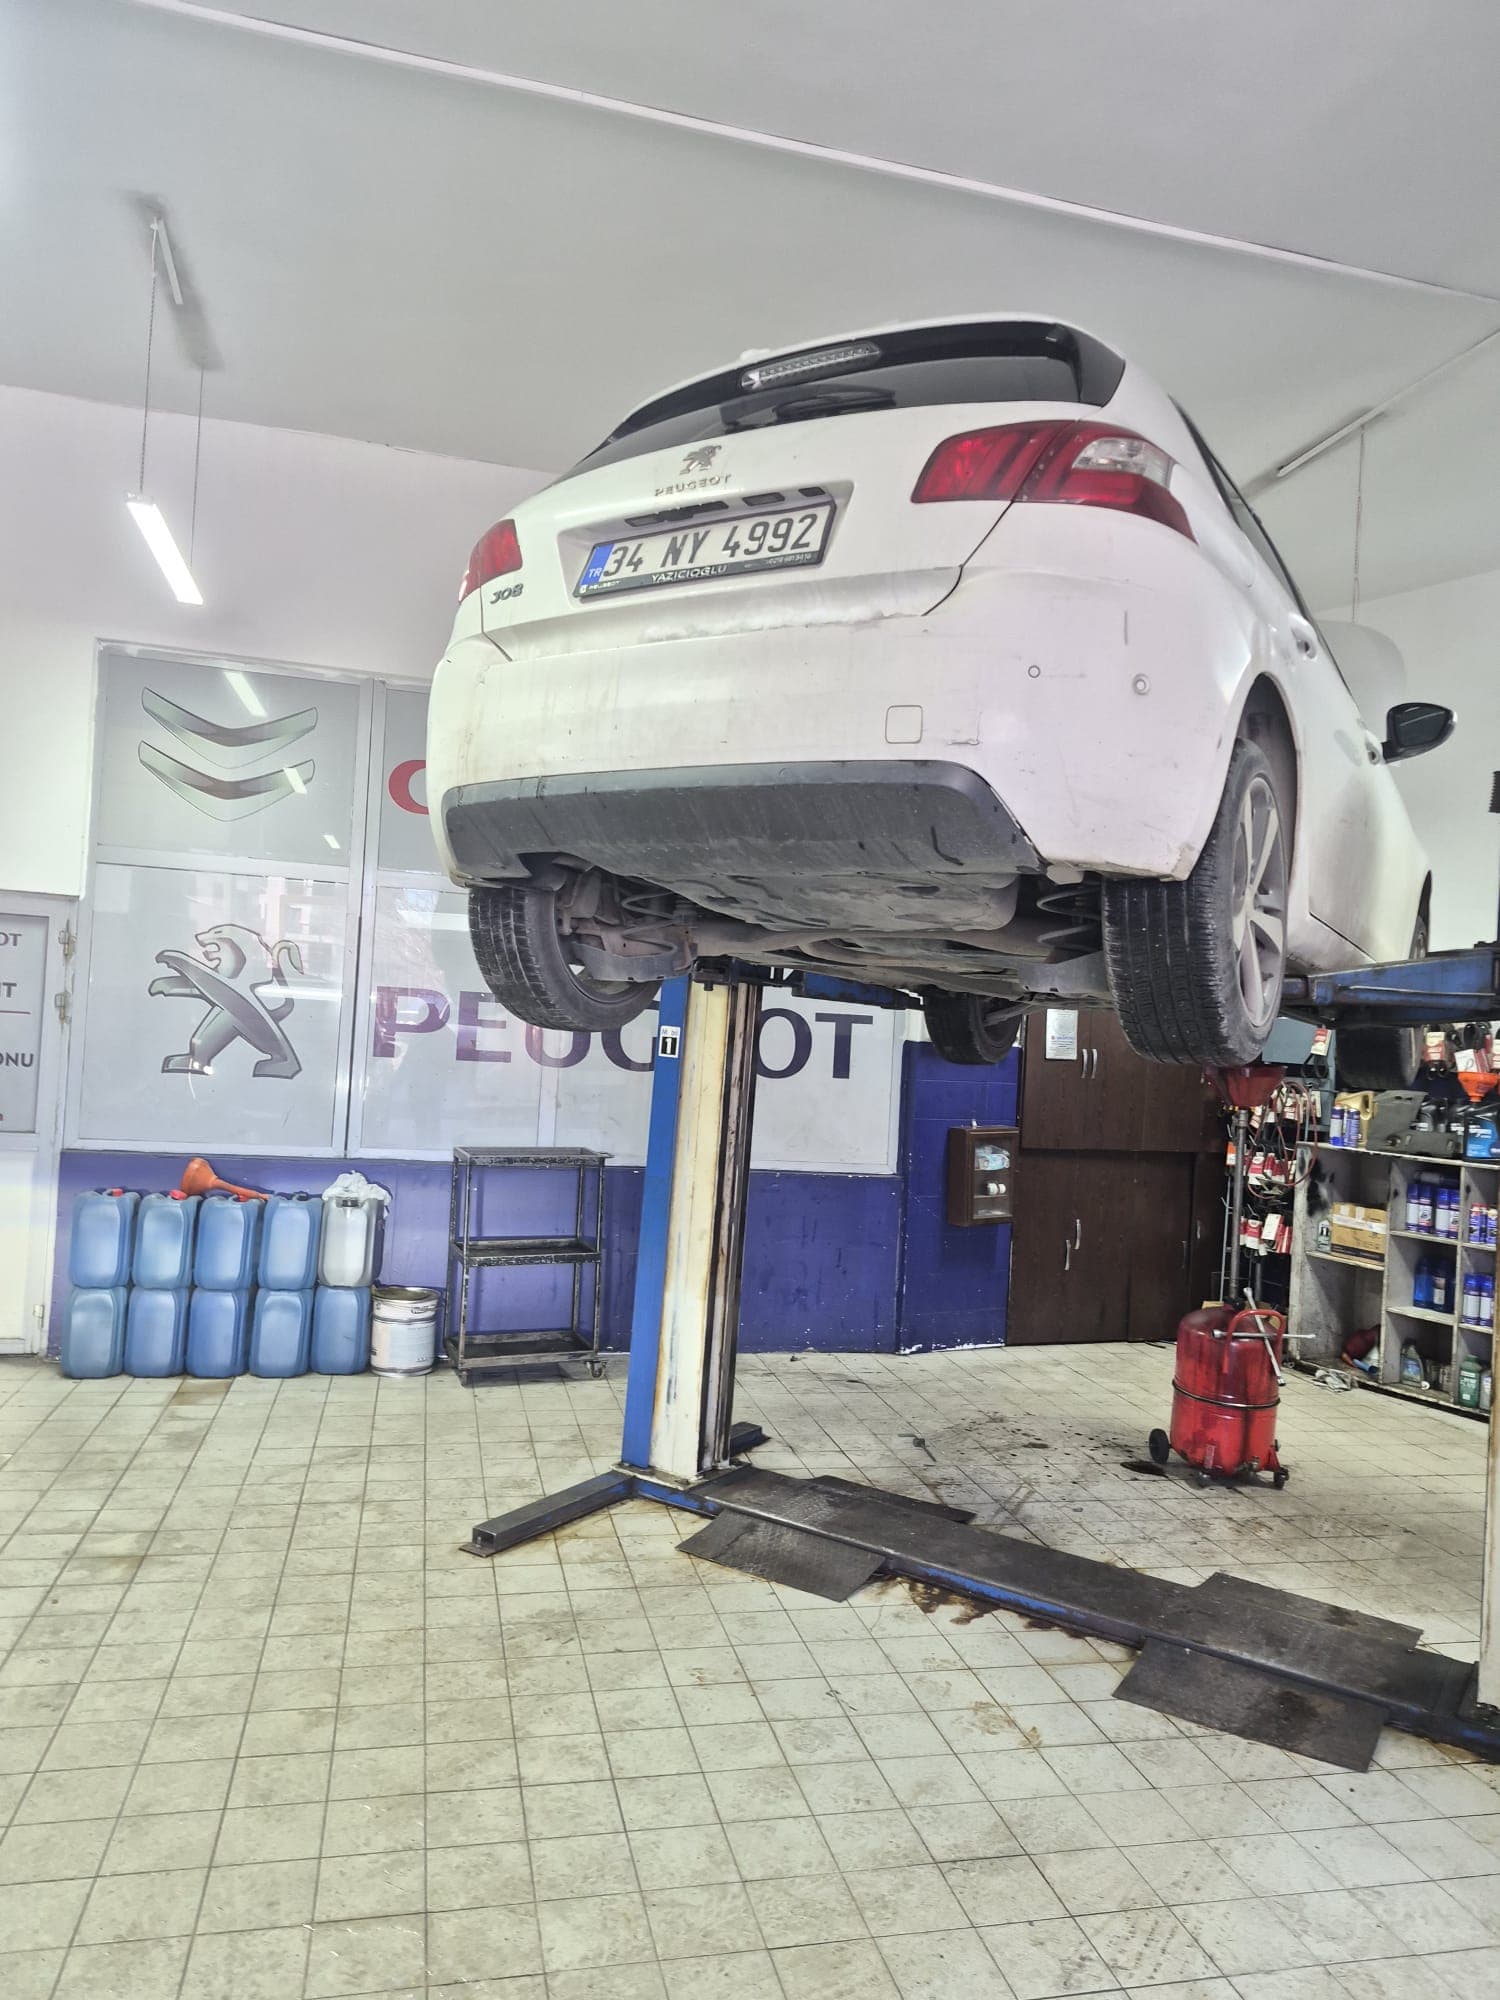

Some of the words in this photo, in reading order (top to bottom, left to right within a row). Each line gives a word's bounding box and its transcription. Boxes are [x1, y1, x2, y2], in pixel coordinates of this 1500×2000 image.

[654, 474, 731, 497] PEUGEOT
[602, 543, 644, 577] 34
[660, 530, 711, 568] NY
[722, 513, 818, 558] 4992
[588, 567, 603, 578] TR
[490, 583, 524, 604] 308
[373, 985, 874, 1080] PEUGOT
